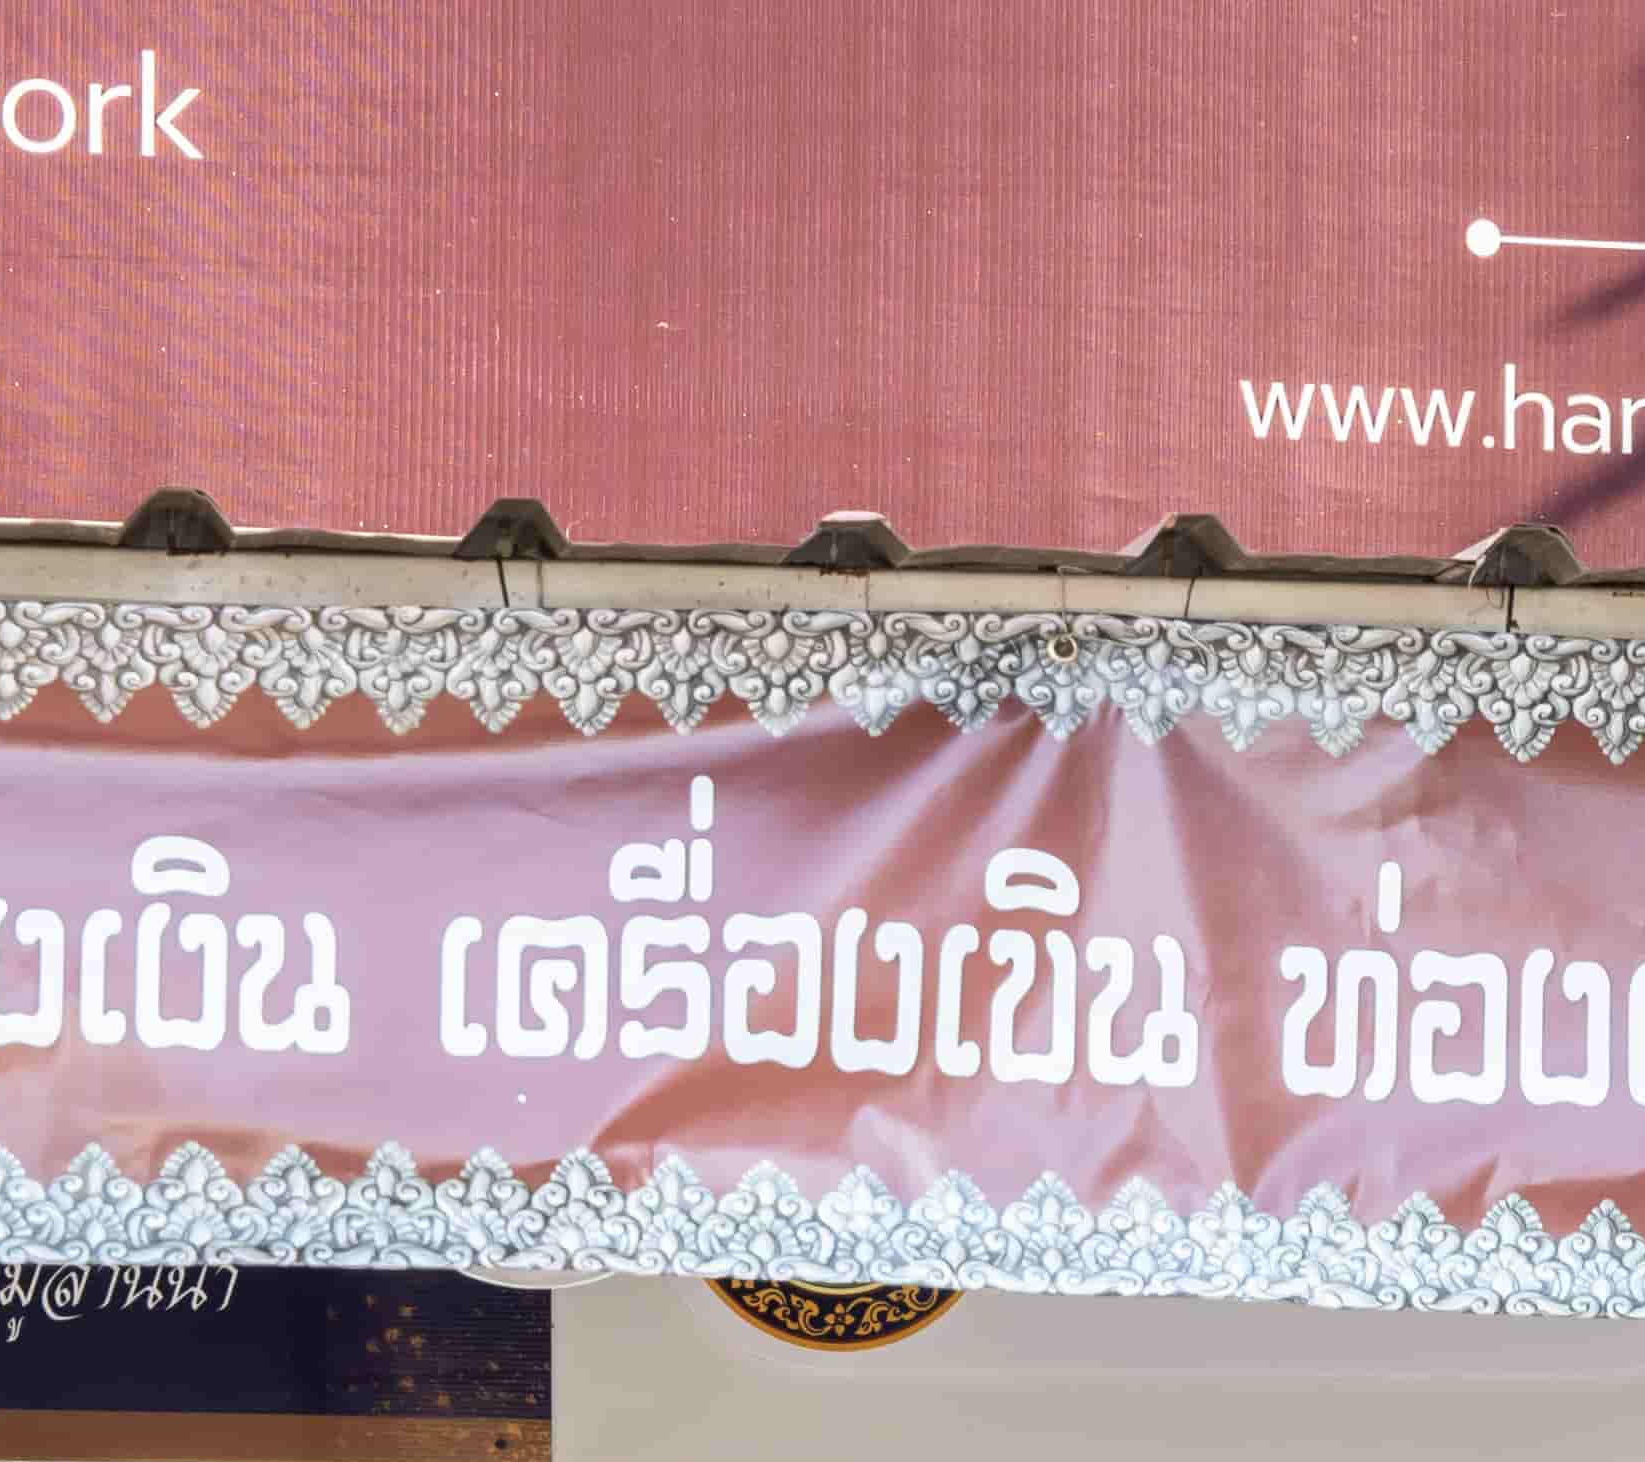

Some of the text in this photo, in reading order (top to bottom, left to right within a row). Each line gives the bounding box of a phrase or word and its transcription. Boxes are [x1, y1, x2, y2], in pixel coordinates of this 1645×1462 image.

[438, 774, 1200, 1089] เครื่องเขิน
